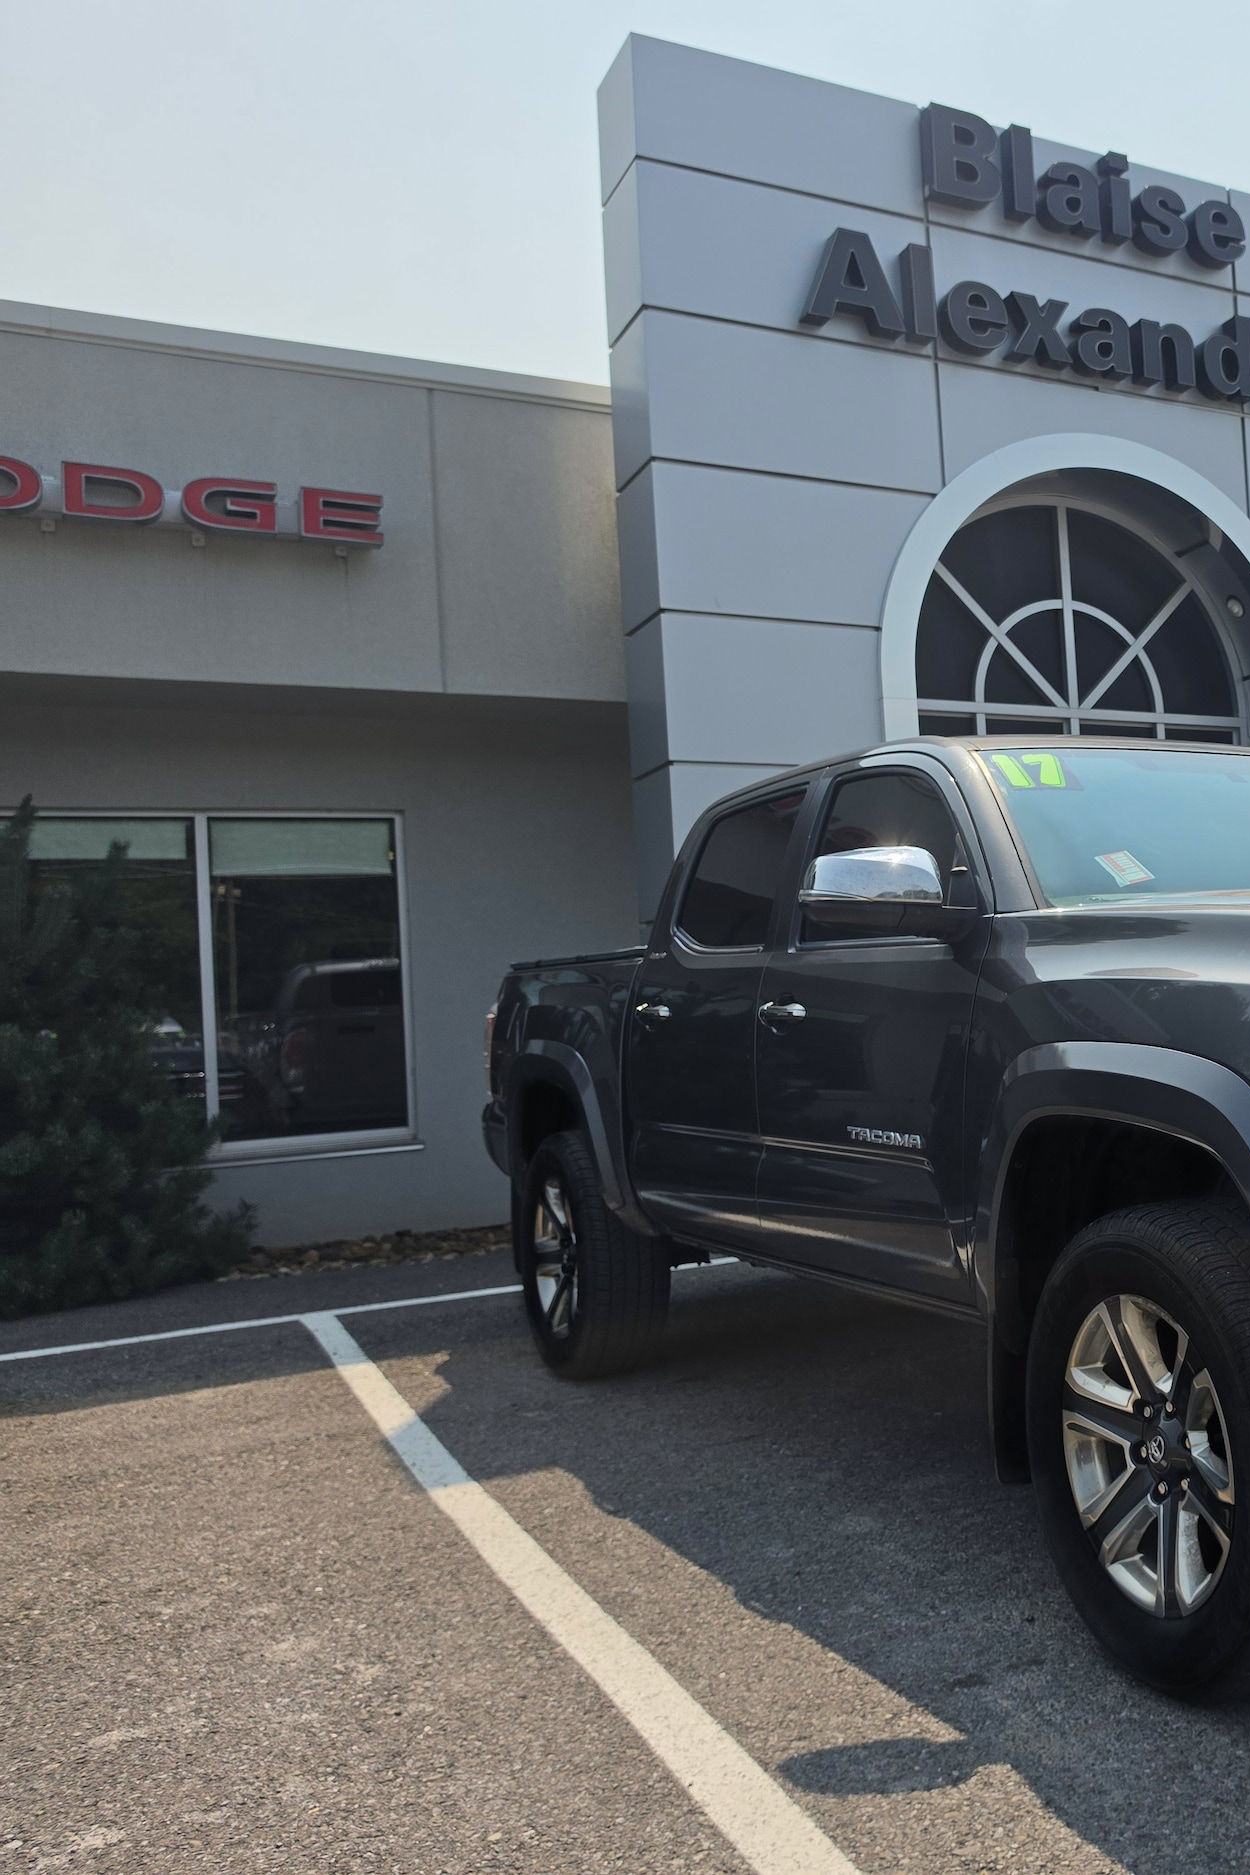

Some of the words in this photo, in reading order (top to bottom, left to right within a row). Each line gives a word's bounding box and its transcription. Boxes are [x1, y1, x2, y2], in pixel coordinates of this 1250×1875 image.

[919, 102, 1246, 269] Blaise
[990, 754, 1066, 788] 17
[847, 1126, 922, 1149] TACOMA
